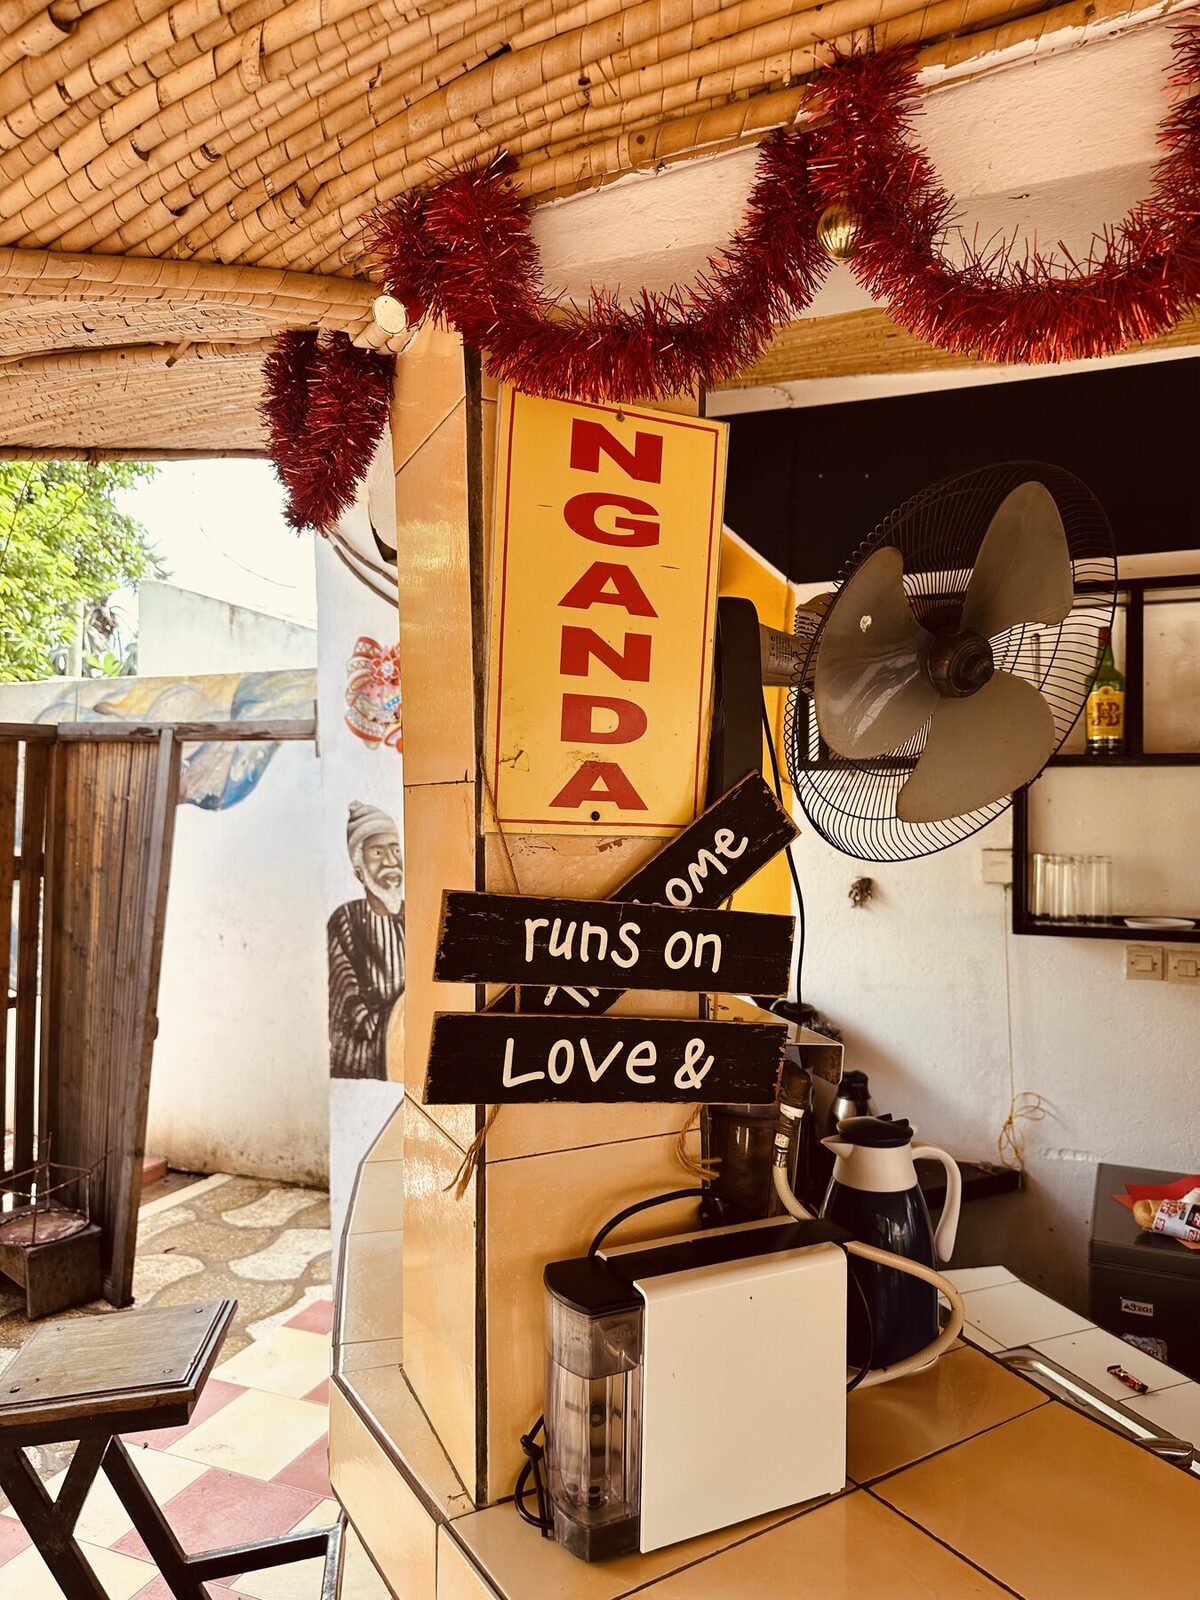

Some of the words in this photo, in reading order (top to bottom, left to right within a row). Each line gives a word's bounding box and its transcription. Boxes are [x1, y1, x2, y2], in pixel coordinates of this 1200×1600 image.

[549, 417, 663, 811] NGANDA
[636, 828, 749, 908] ome
[524, 917, 640, 969] runs
[664, 930, 722, 974] on
[502, 1037, 657, 1088] Love
[673, 1037, 715, 1090] &
